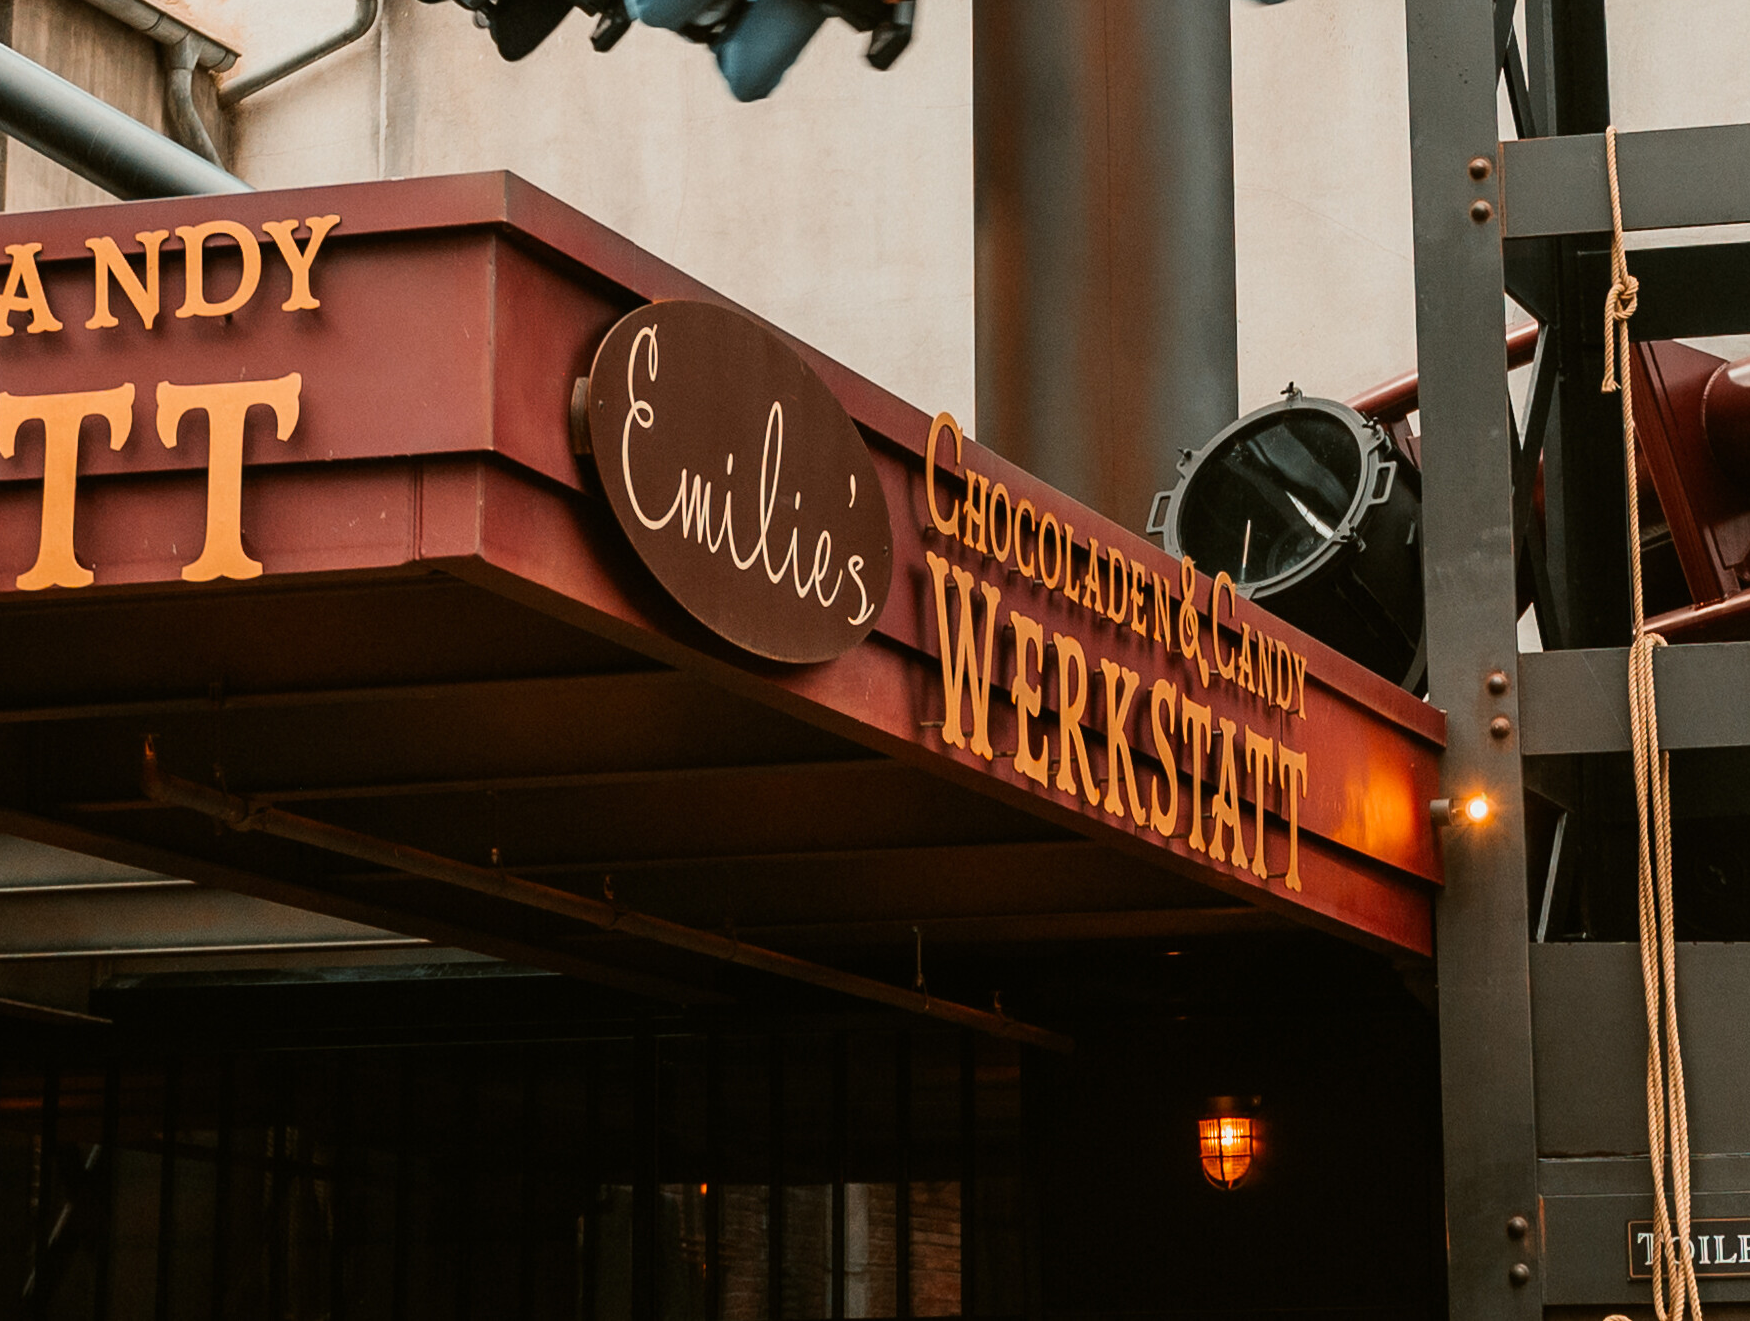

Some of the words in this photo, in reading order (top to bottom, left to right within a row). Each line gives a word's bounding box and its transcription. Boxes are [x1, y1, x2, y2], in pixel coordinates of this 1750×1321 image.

[622, 323, 875, 625] Emilie's
[926, 412, 1172, 652] CHOCOLADEN
[1178, 555, 1209, 688] &
[1211, 571, 1307, 721] CANDY
[926, 551, 1308, 892] WERKSTATT
